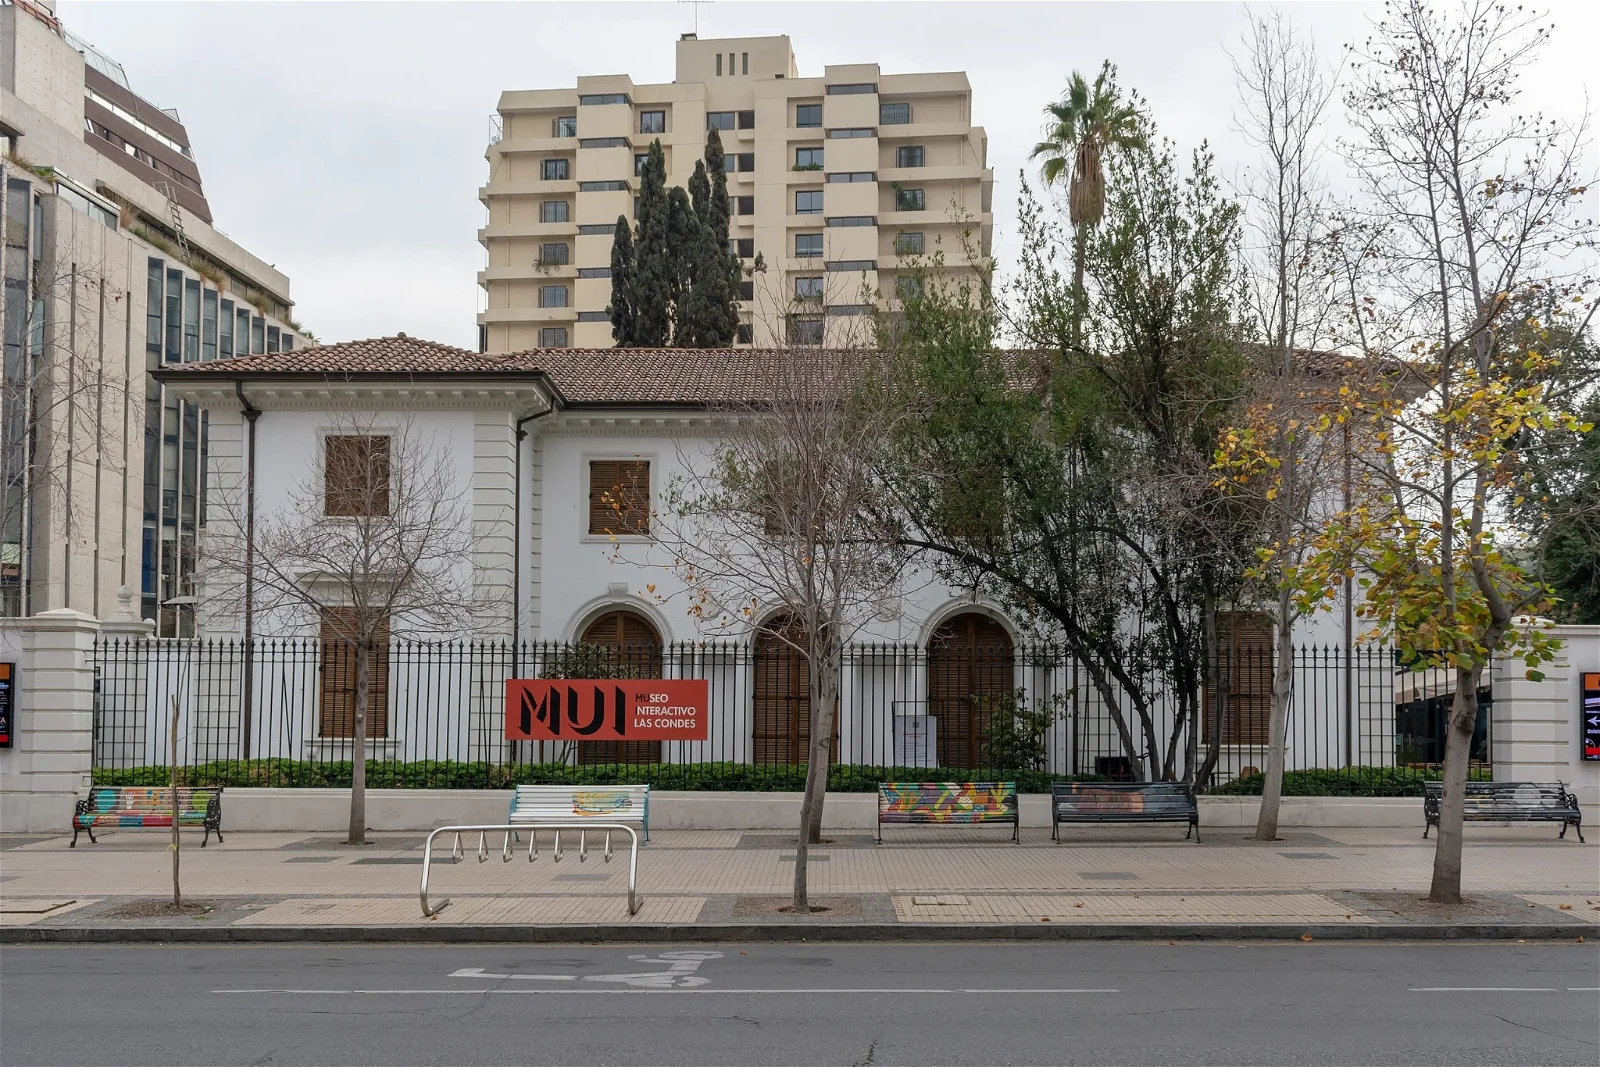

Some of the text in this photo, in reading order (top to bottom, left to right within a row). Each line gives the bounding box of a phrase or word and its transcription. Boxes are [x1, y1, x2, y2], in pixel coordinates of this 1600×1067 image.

[635, 693, 669, 703] MUSEO
[518, 685, 626, 735] MUI
[635, 706, 696, 716] INTERACTIVO
[634, 718, 696, 728] LAS CONDES
